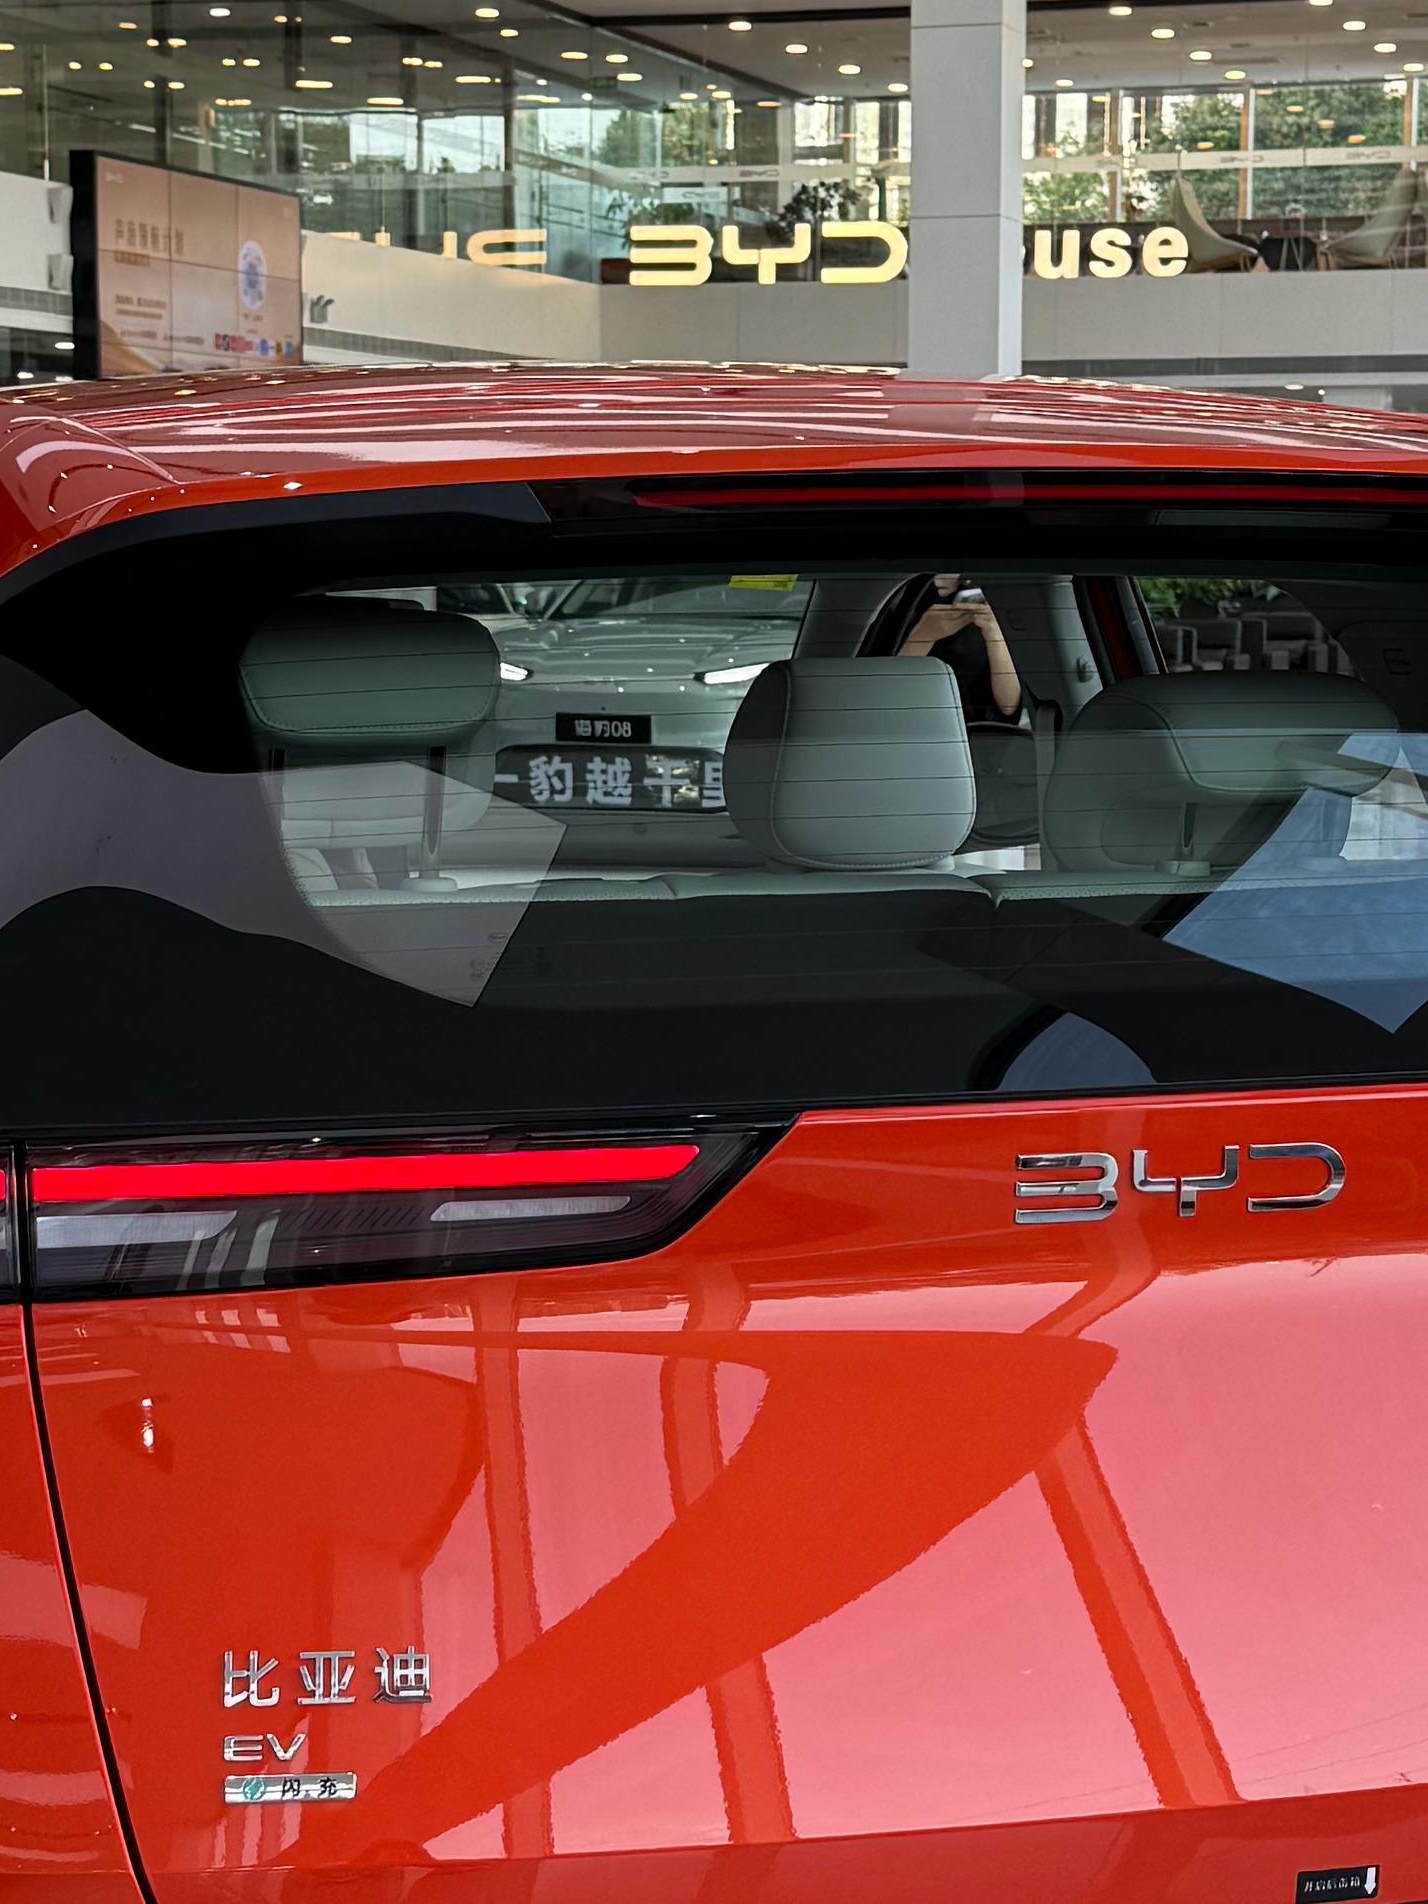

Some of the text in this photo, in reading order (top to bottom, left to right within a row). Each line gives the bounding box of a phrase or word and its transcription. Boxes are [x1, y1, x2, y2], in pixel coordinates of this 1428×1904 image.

[629, 220, 1190, 287] BYD use
[1014, 1141, 1346, 1225] BYD
[223, 1645, 433, 1708] 比亚迪
[223, 1732, 307, 1762] EV
